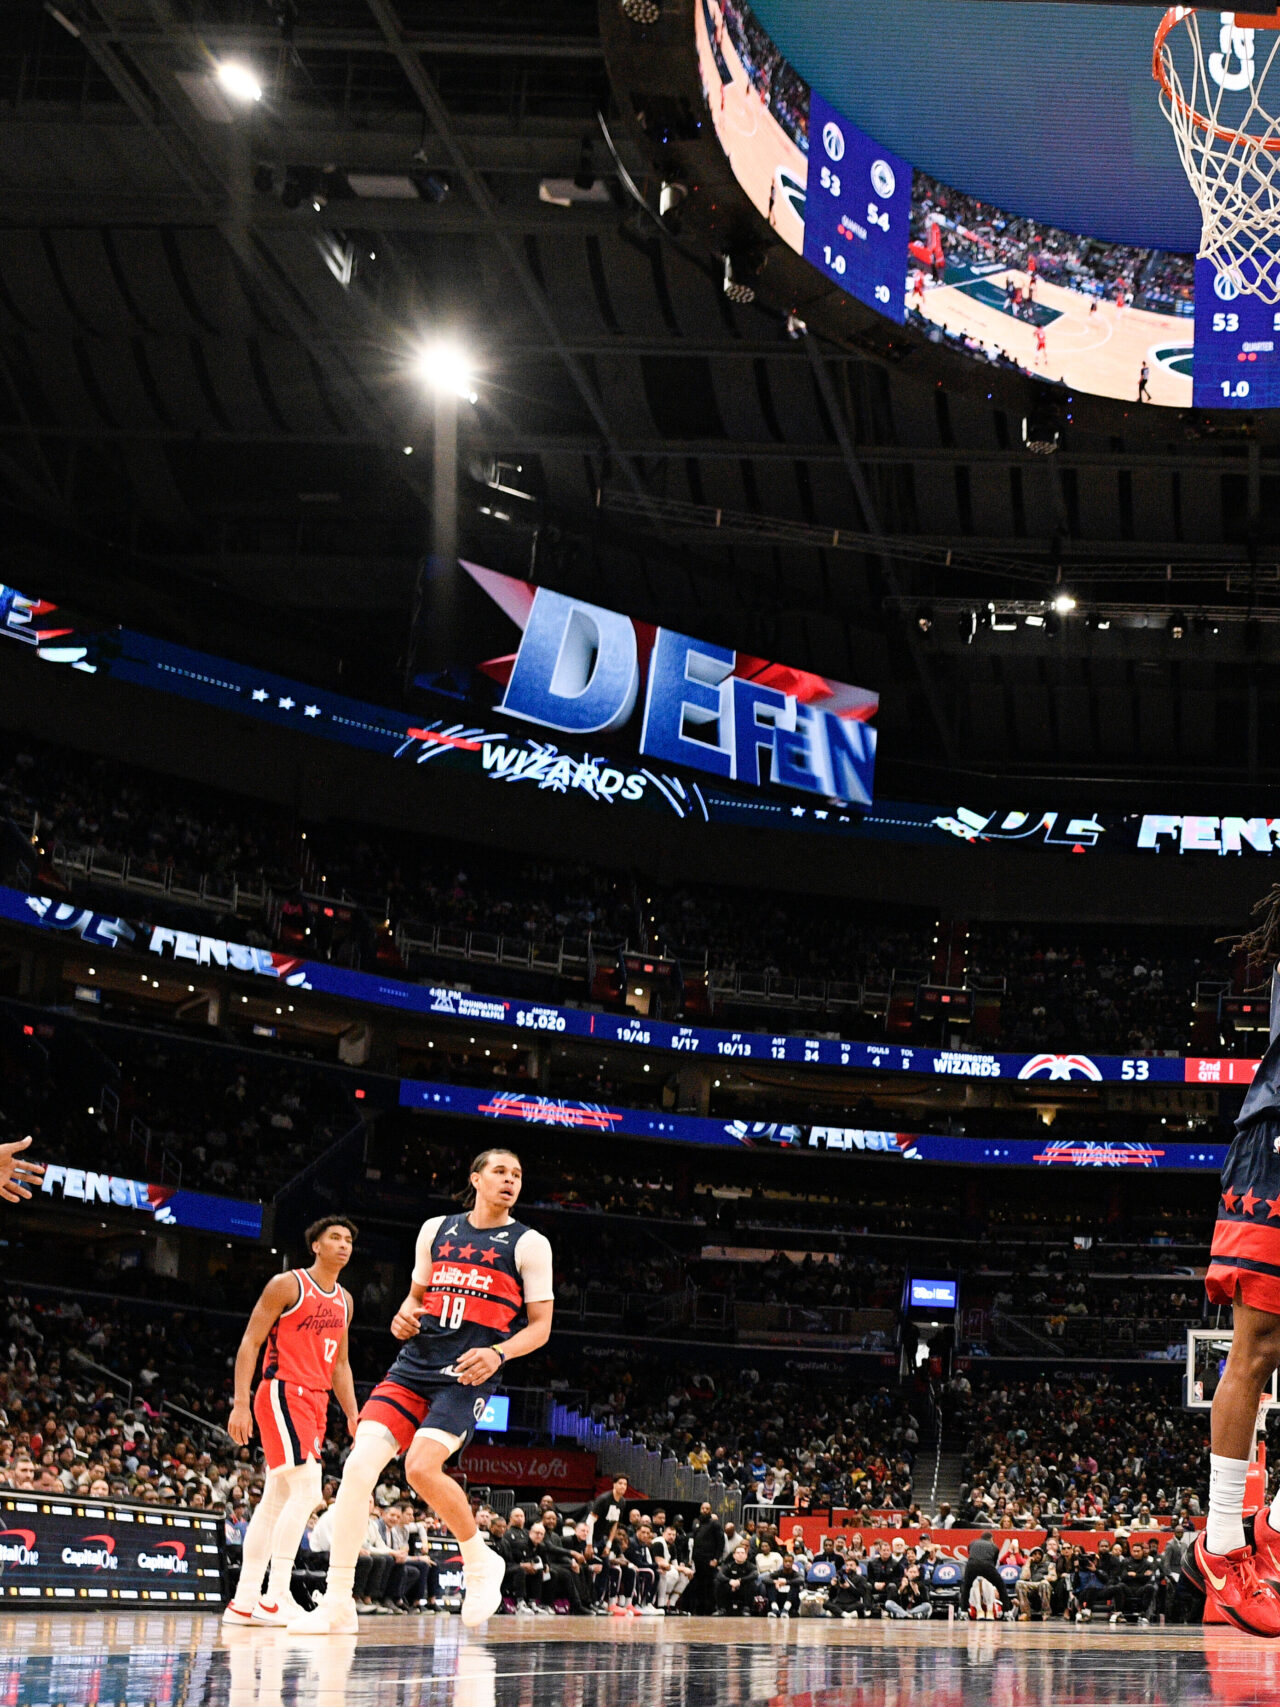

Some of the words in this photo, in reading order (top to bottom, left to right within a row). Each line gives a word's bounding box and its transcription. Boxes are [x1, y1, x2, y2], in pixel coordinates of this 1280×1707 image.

[820, 165, 841, 197] 53
[867, 202, 890, 232] 54
[823, 245, 846, 275] 1.0
[1212, 312, 1239, 332] 53
[1220, 380, 1250, 398] 1.0
[481, 744, 647, 801] WIZARDS
[149, 926, 282, 977] FENSE
[516, 1010, 567, 1032] $5,020
[616, 1028, 651, 1044] 19/45
[671, 1036, 699, 1051] 5/17
[717, 1042, 751, 1056] 10/13
[771, 1046, 786, 1059] 12
[804, 1050, 820, 1062] 34
[867, 1045, 890, 1055] FOULS
[940, 1052, 995, 1063] WASHINGTON
[841, 1053, 849, 1065] 9
[872, 1056, 881, 1067] 4
[902, 1058, 910, 1070] 5
[933, 1058, 1001, 1077] WIZARDS
[1198, 1061, 1221, 1072] 2nd
[1121, 1060, 1149, 1081] 53
[1198, 1071, 1221, 1081] QTR
[808, 1126, 904, 1153] FENSE
[41, 1164, 155, 1211] FENSE
[432, 1264, 493, 1291] district
[314, 1303, 333, 1318] Los
[439, 1295, 466, 1329] 18
[297, 1315, 344, 1336] Angeles
[323, 1337, 338, 1364] 12
[459, 1457, 524, 1479] ennessy
